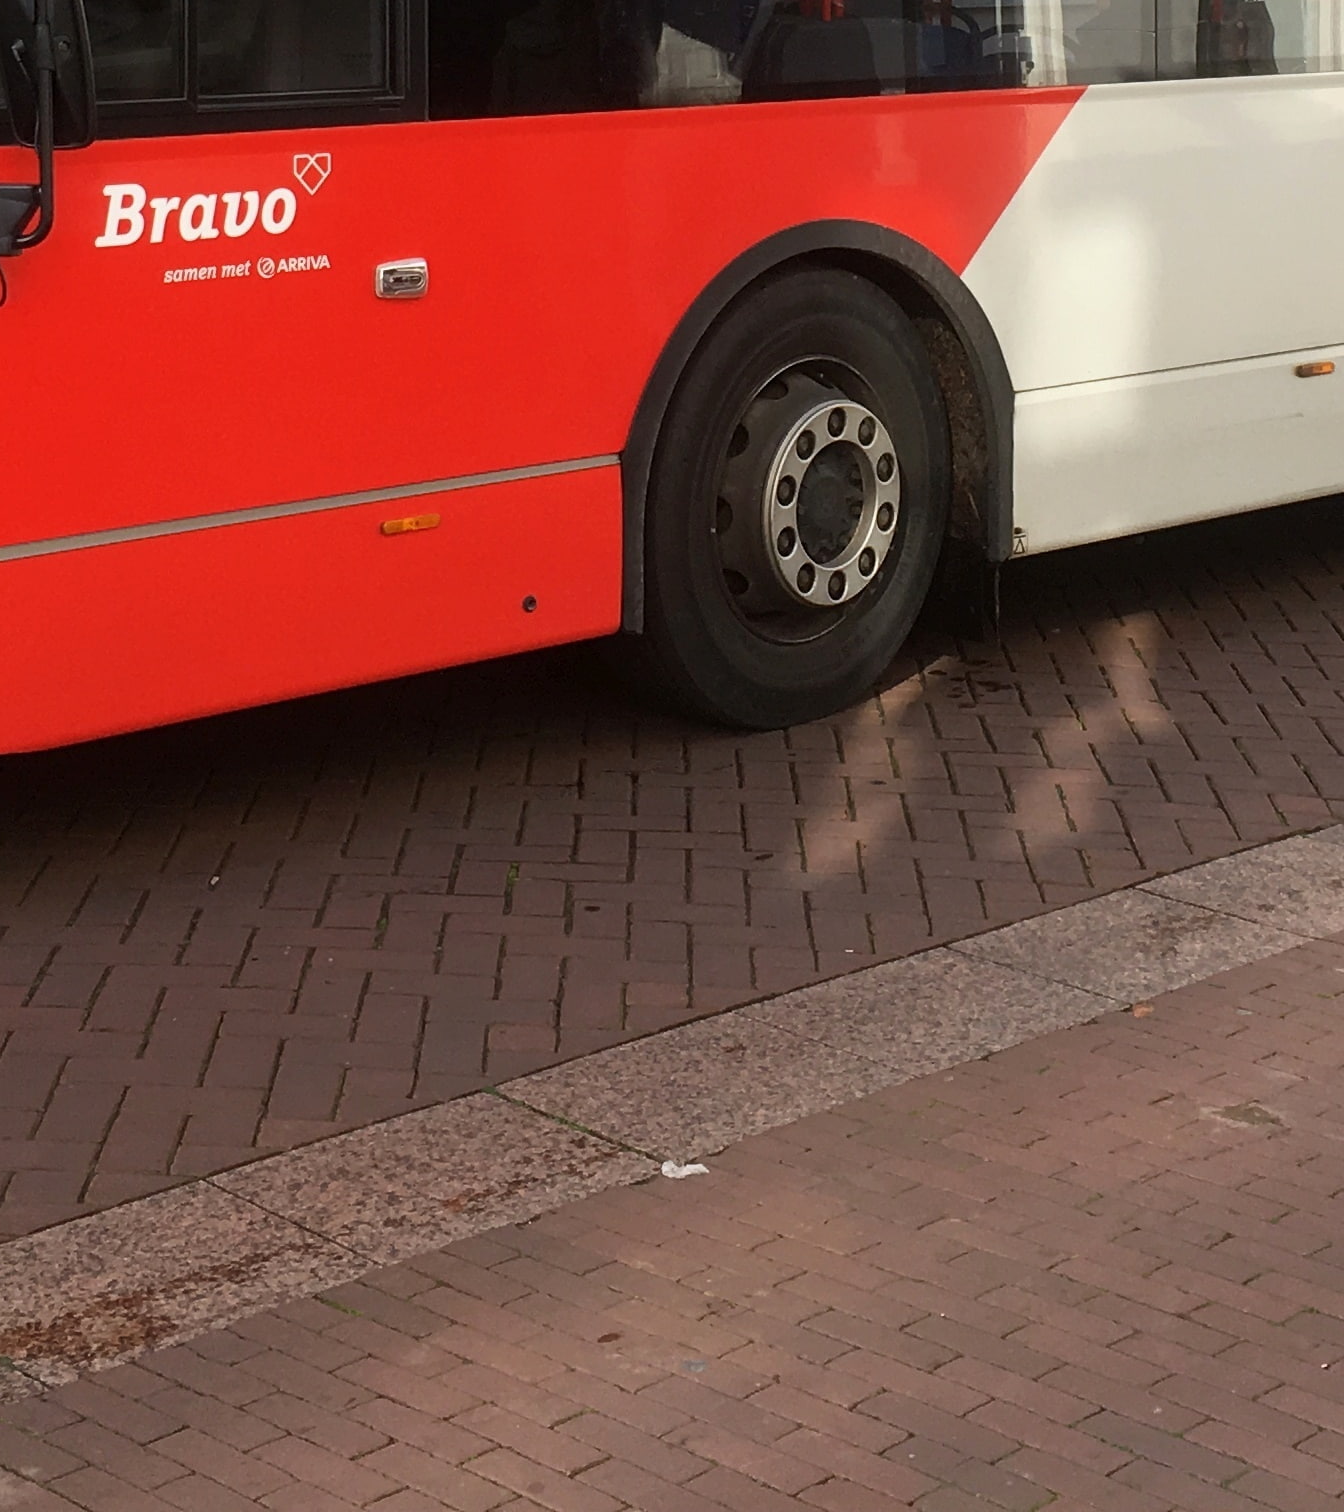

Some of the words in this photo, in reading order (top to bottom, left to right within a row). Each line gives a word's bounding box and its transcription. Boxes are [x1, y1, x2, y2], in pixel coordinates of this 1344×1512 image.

[94, 183, 297, 248] Bravo
[163, 265, 217, 284] samen
[221, 260, 251, 279] met
[276, 254, 331, 273] ARRIVA
